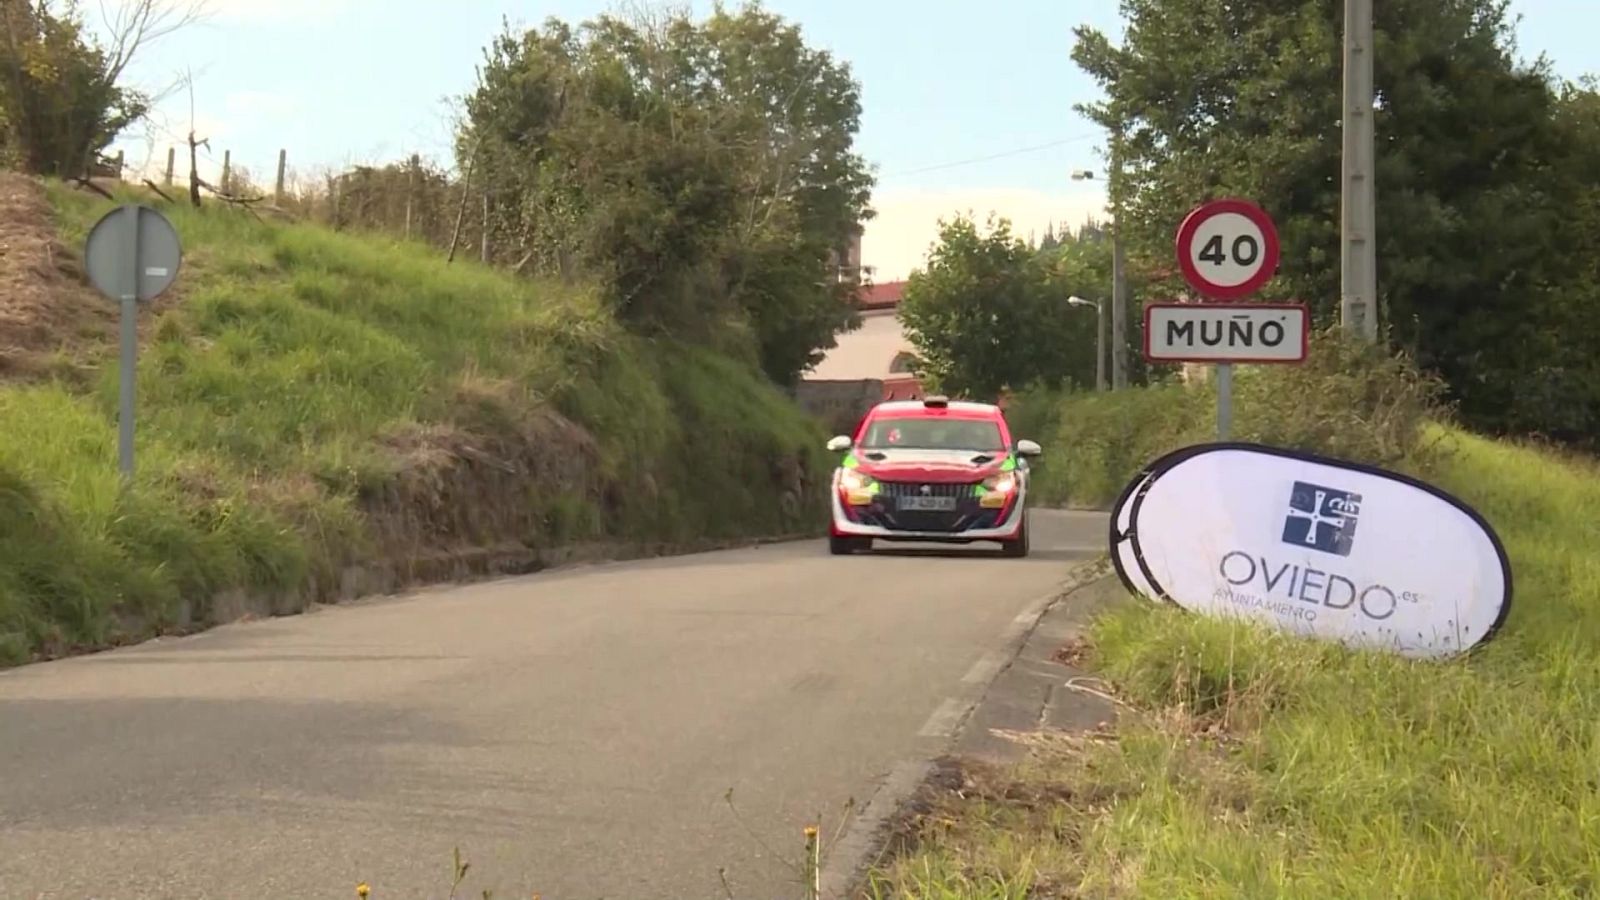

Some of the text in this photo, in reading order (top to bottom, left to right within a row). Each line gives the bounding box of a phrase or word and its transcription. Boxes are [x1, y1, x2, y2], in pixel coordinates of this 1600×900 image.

[1198, 234, 1258, 266] 40
[1219, 550, 1397, 620] OVIEDO
[1213, 587, 1317, 622] AYUNTAMIENTO
